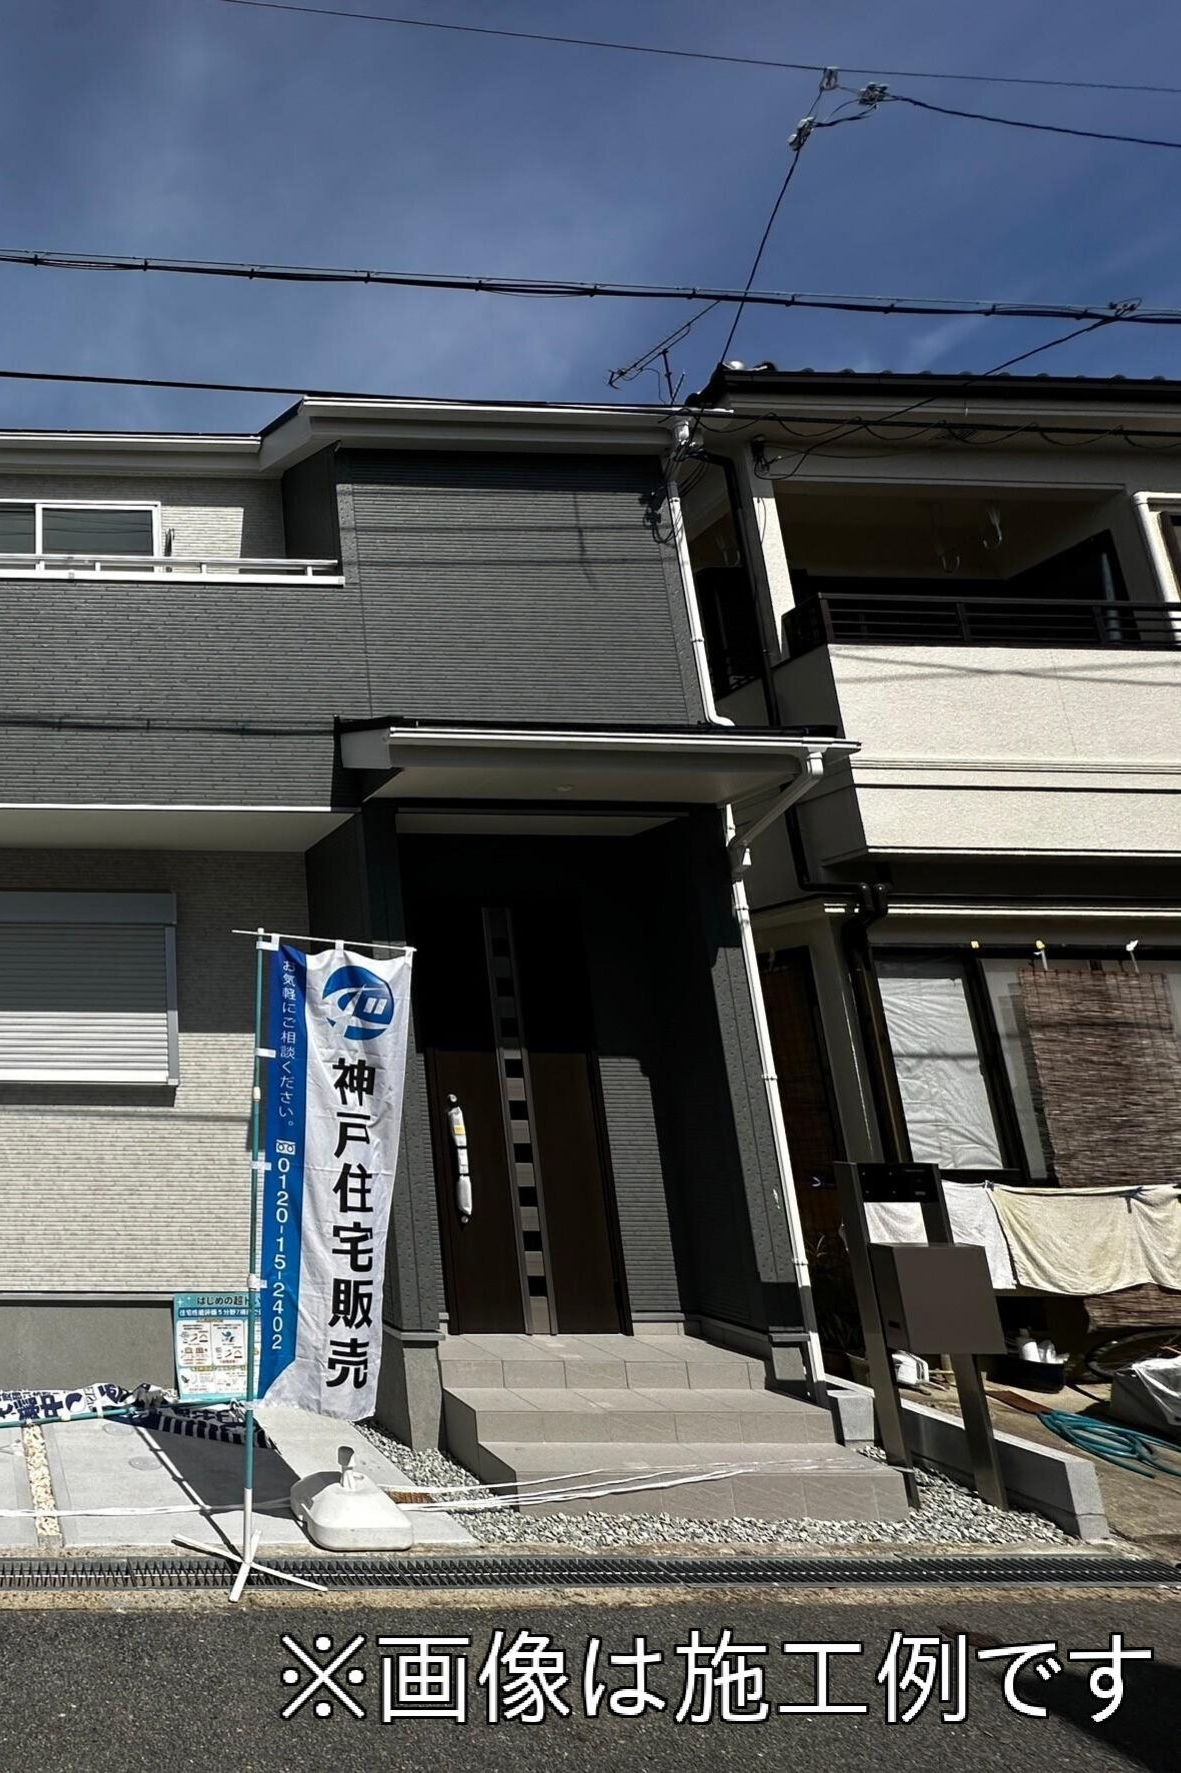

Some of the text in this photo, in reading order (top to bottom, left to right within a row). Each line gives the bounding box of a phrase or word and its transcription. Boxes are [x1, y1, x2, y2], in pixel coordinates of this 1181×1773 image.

[279, 960, 297, 1127] お気軽にご相談ください。
[272, 1158, 291, 1350] 0120-15-2402
[325, 1057, 376, 1390] 神戸住宅販売
